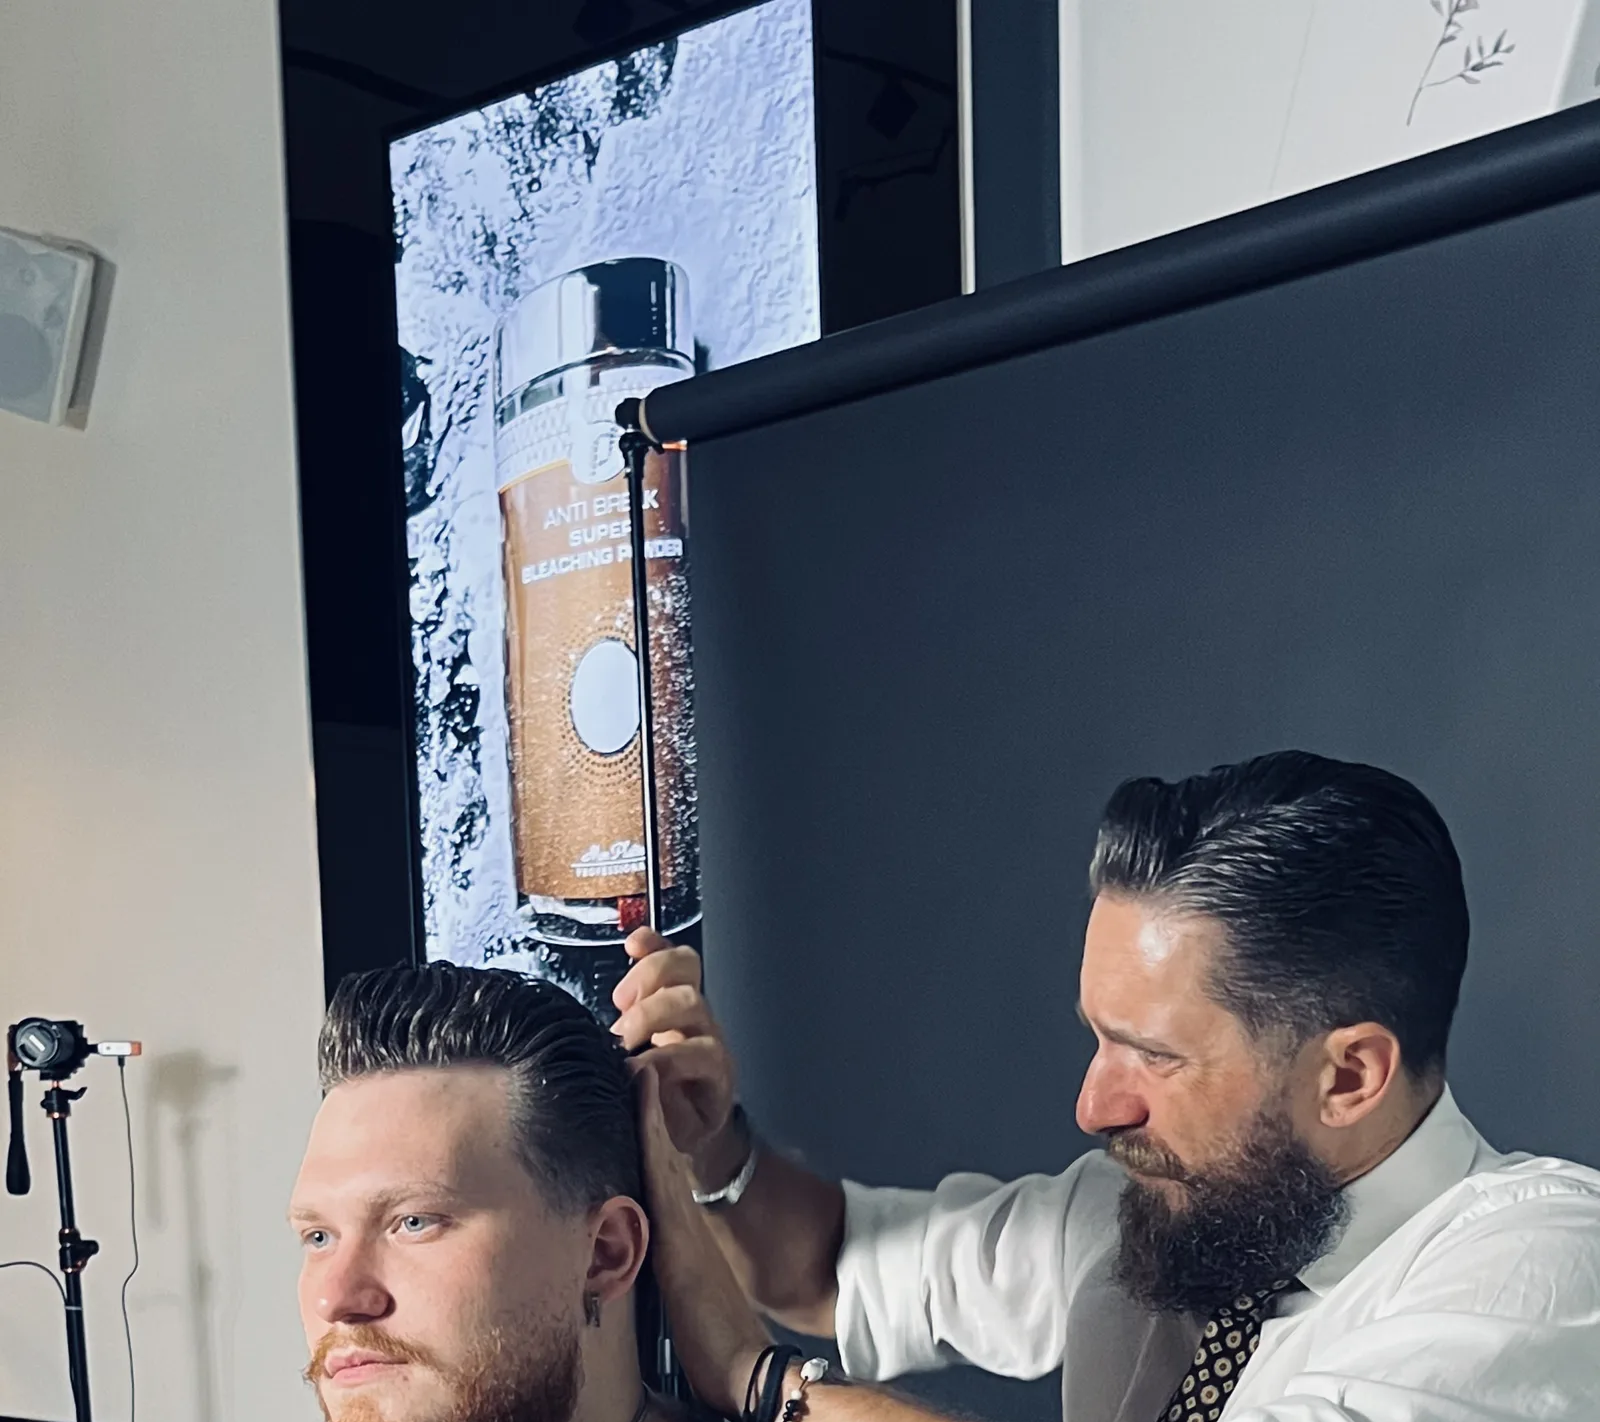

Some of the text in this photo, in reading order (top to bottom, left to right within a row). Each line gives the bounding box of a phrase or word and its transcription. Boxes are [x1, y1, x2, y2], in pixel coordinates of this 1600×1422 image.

[545, 489, 659, 528] ANTI BREK
[522, 548, 613, 583] BLEACHING
